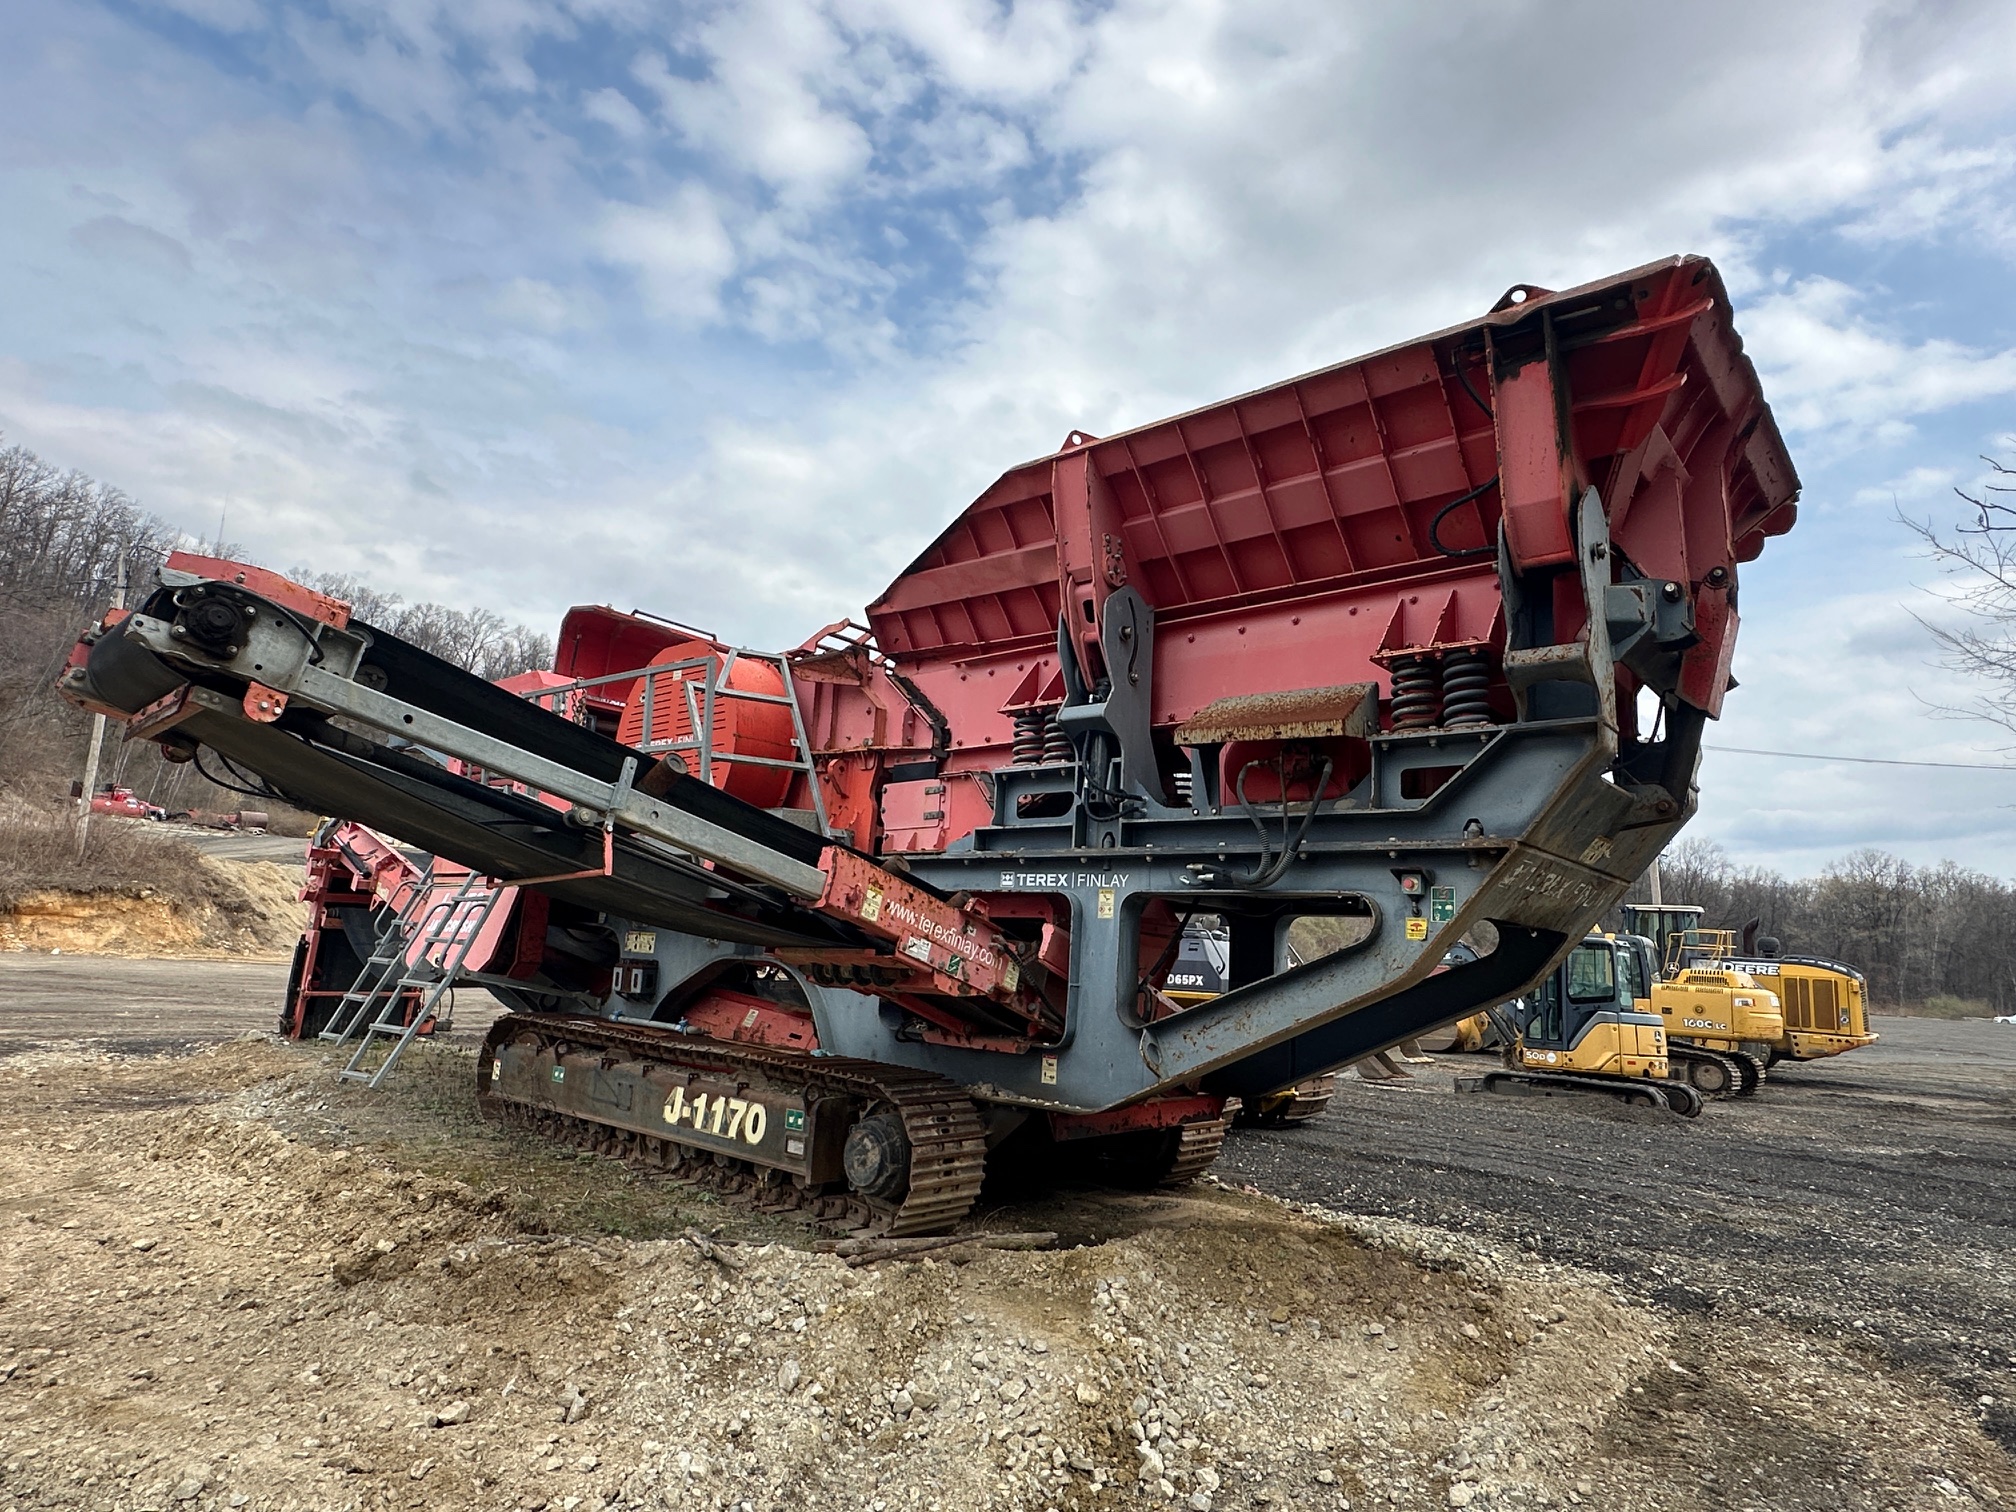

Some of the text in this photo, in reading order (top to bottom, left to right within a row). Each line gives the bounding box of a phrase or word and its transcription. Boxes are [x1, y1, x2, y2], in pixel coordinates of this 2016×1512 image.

[1017, 873, 1129, 888] TEREX FINLAY
[1722, 961, 1780, 976] DEERE
[1166, 973, 1204, 986] D65PX
[1682, 1018, 1713, 1029] 160C
[663, 1086, 767, 1145] J-1170
